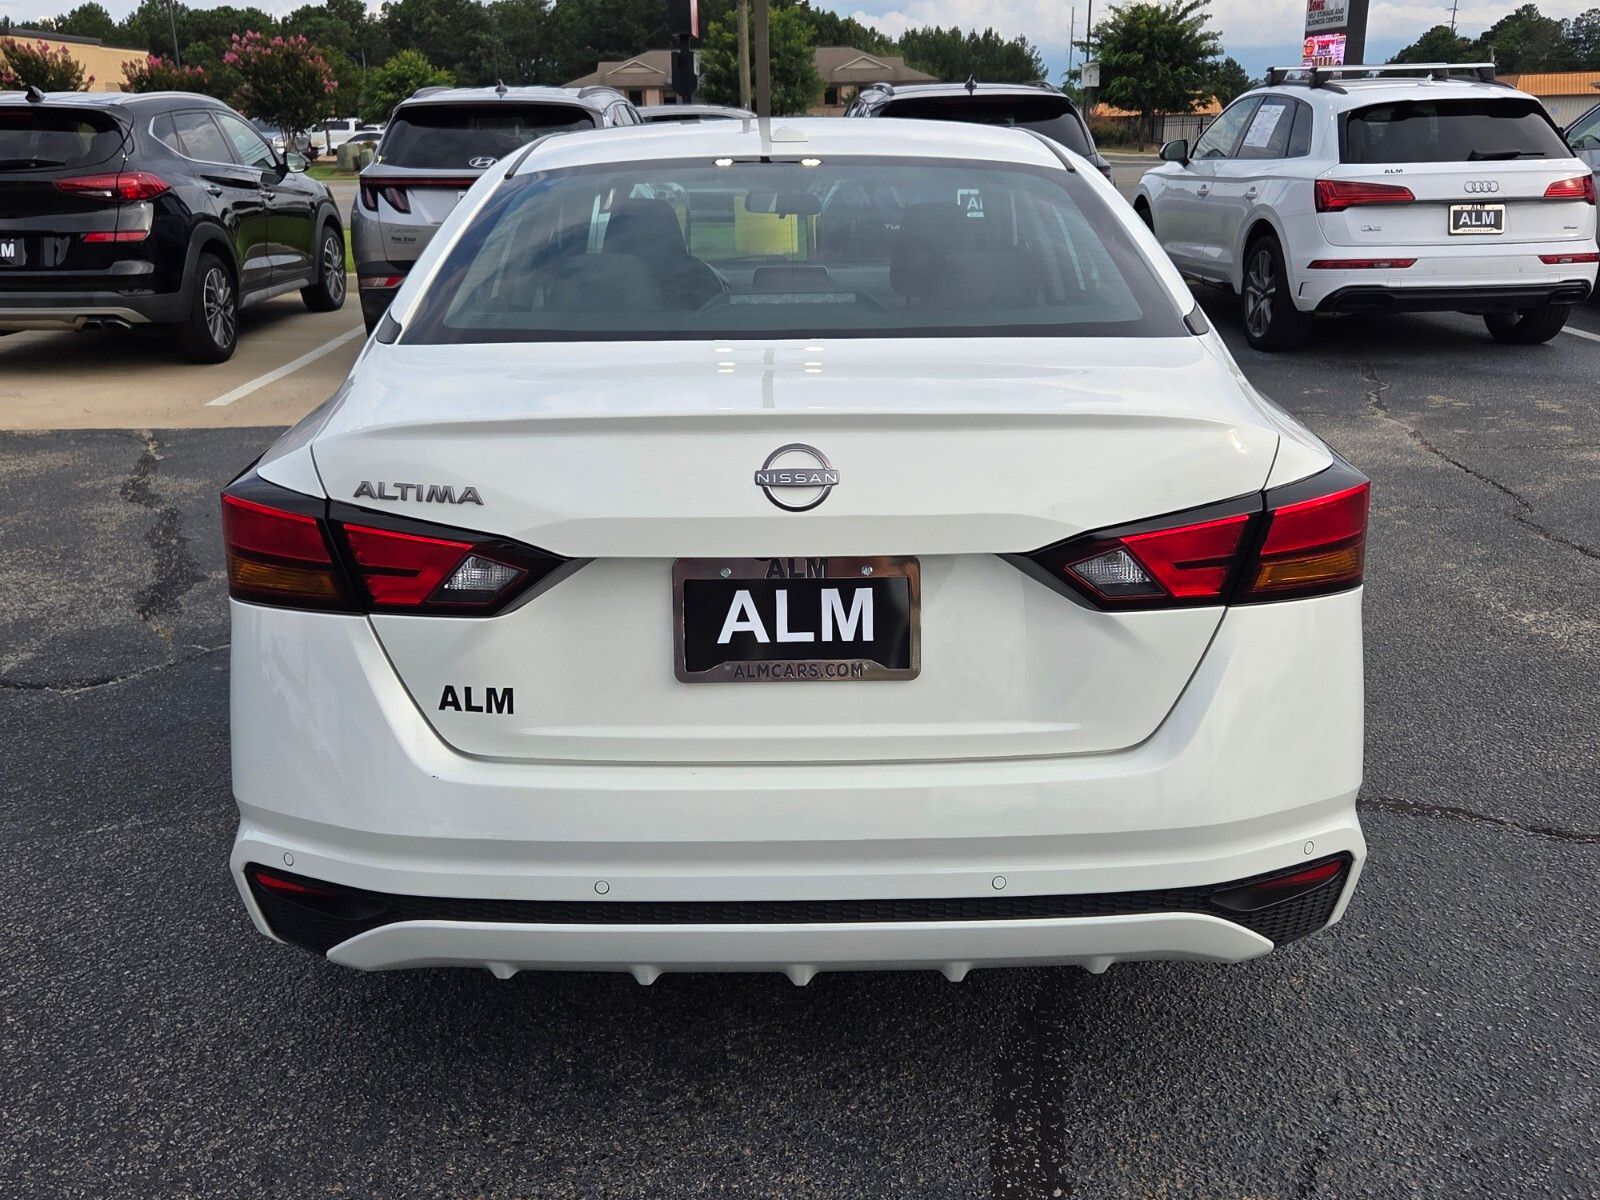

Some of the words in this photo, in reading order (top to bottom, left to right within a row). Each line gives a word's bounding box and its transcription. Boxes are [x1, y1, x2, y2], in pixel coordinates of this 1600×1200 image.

[1459, 211, 1495, 225] ALM
[757, 473, 837, 483] NISSAN
[353, 480, 484, 506] ALTIMA
[765, 556, 829, 579] ALM
[717, 587, 874, 644] ALM
[733, 662, 864, 679] ALMCARS.COM
[438, 684, 514, 715] ALM
